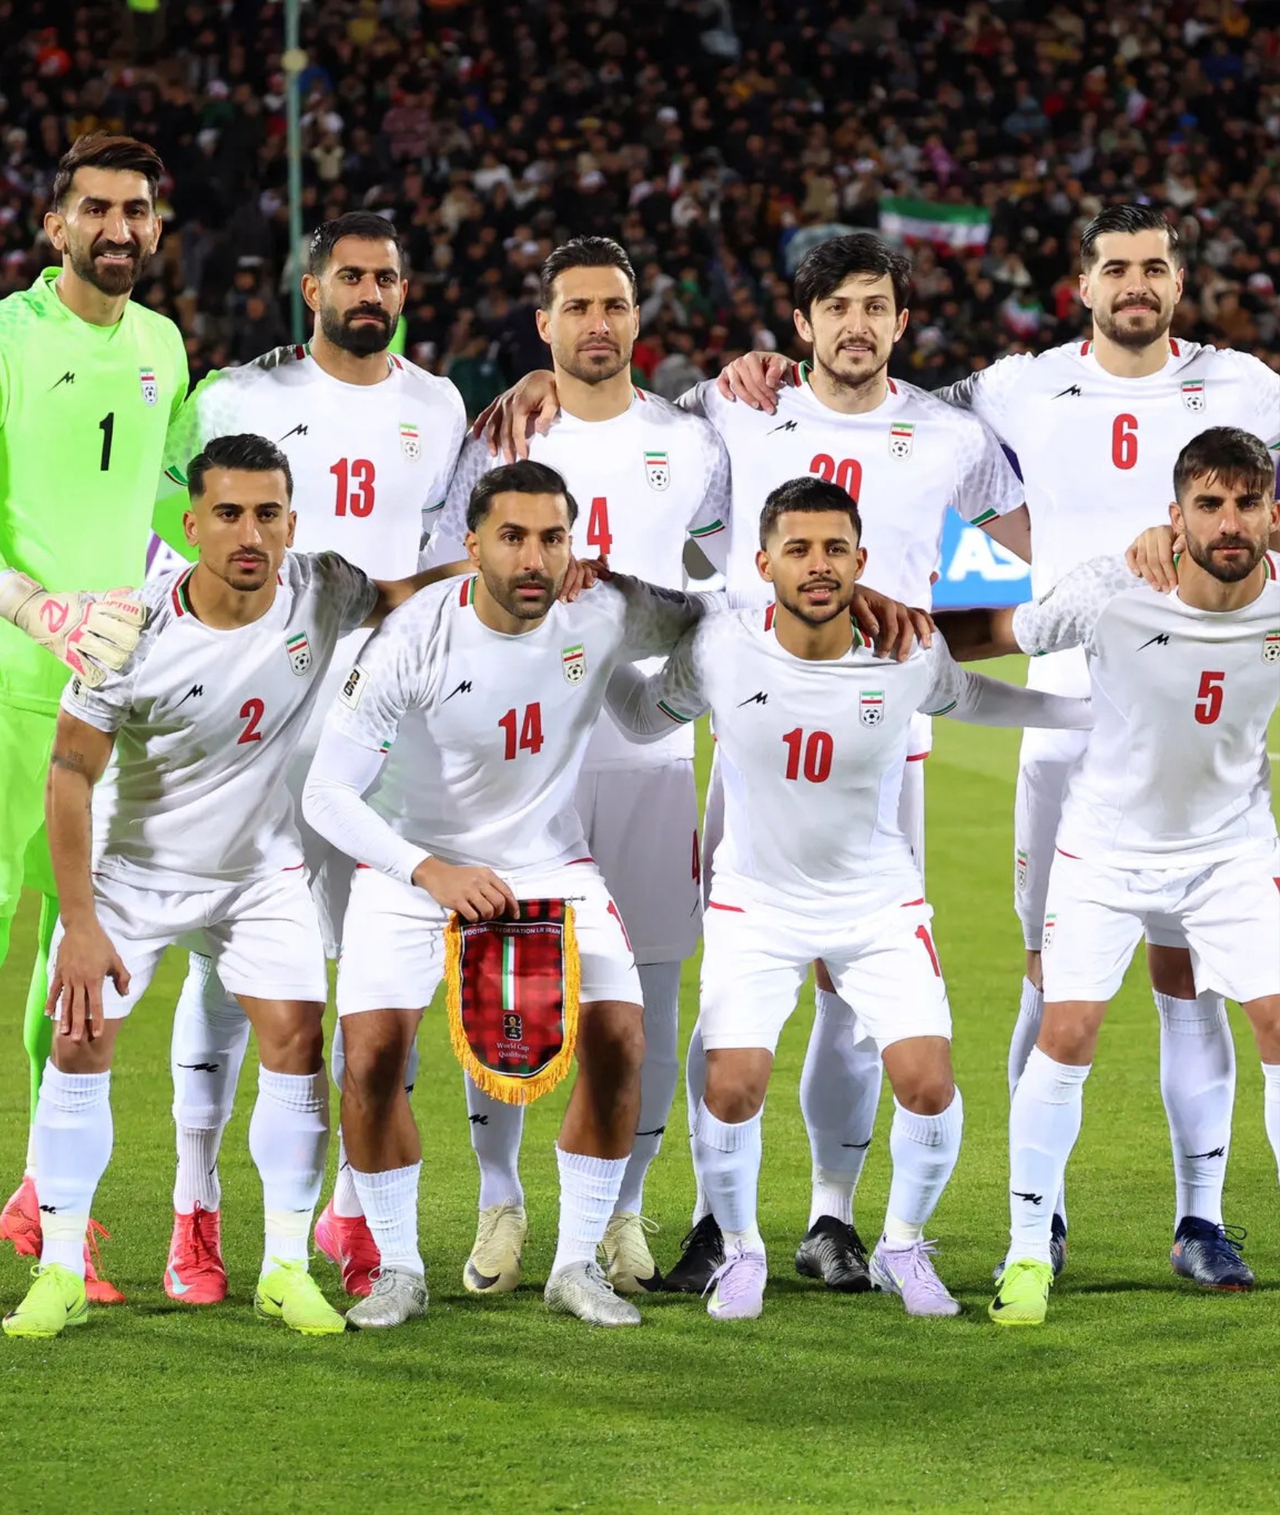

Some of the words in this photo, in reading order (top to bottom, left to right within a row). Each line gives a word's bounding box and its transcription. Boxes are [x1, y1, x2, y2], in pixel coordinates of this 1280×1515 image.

[99, 412, 115, 472] 1
[1112, 413, 1139, 470] 6
[329, 458, 376, 518] 13
[237, 698, 265, 744] 2
[1194, 671, 1226, 725] 5
[498, 702, 545, 760] 14
[782, 727, 834, 783] 10
